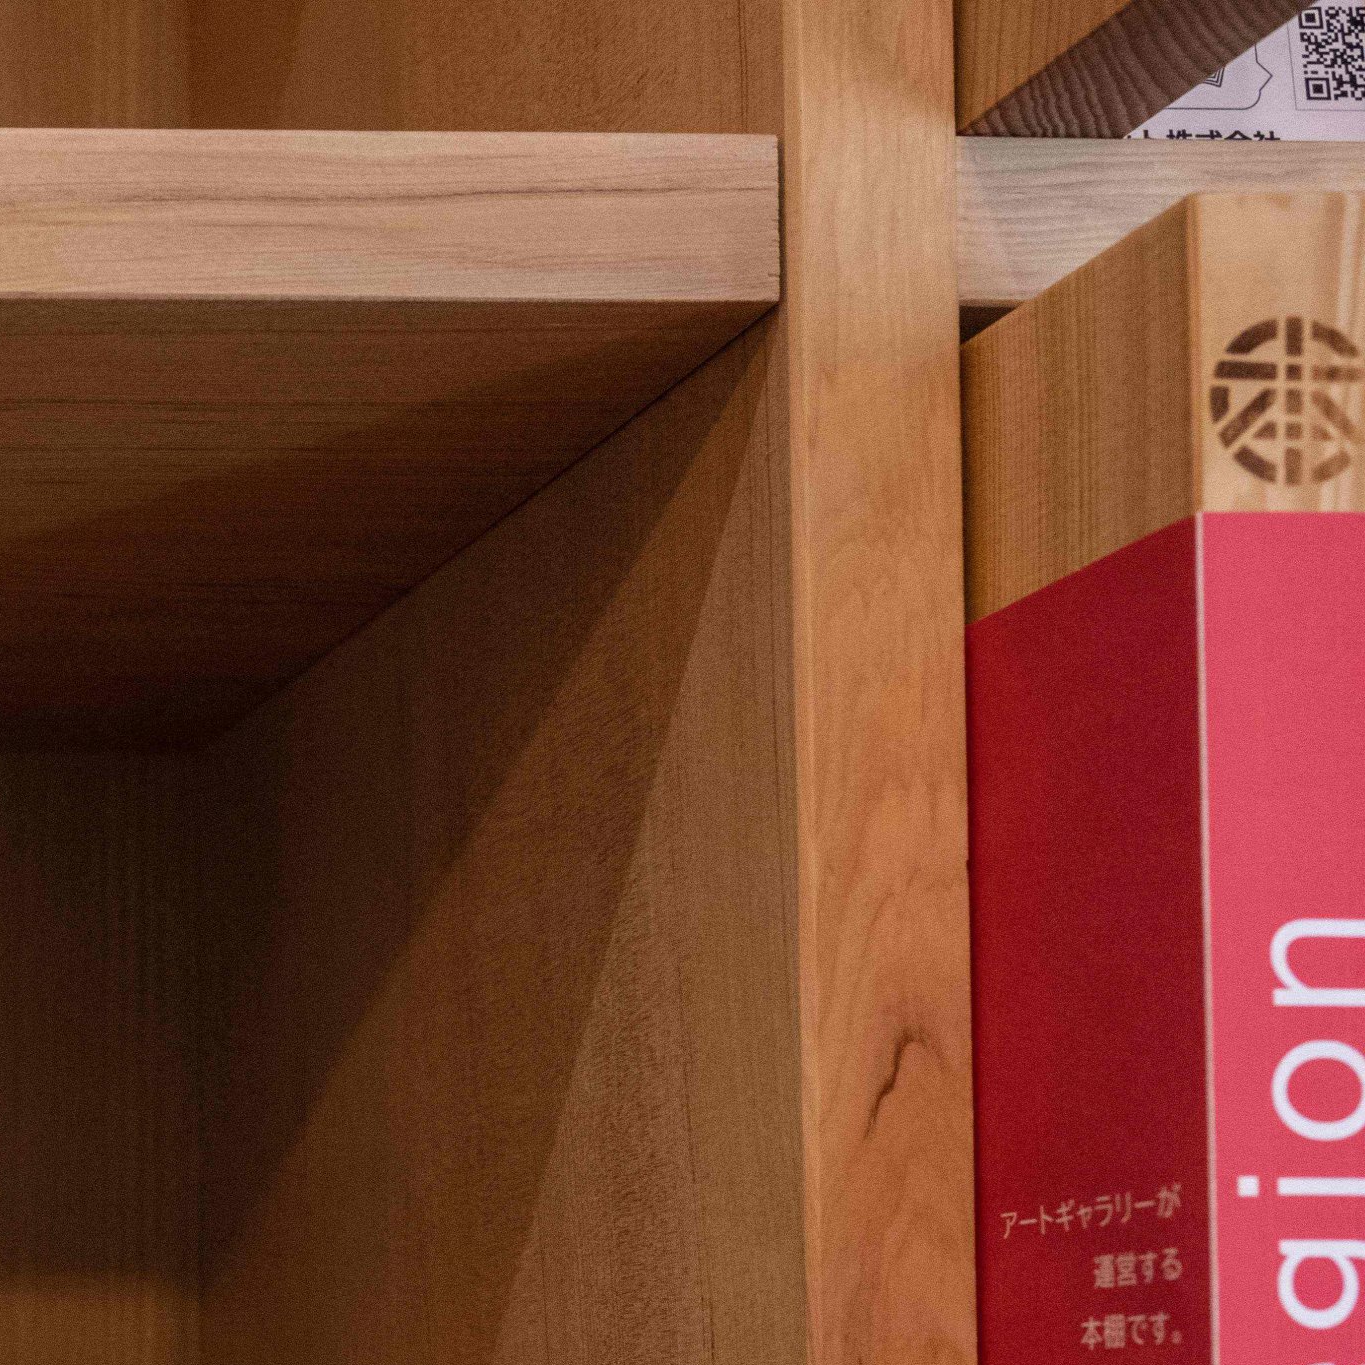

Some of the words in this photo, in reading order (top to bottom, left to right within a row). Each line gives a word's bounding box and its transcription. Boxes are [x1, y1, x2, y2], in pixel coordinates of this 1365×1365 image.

[1000, 1184, 1182, 1239] アートギャラリーが
